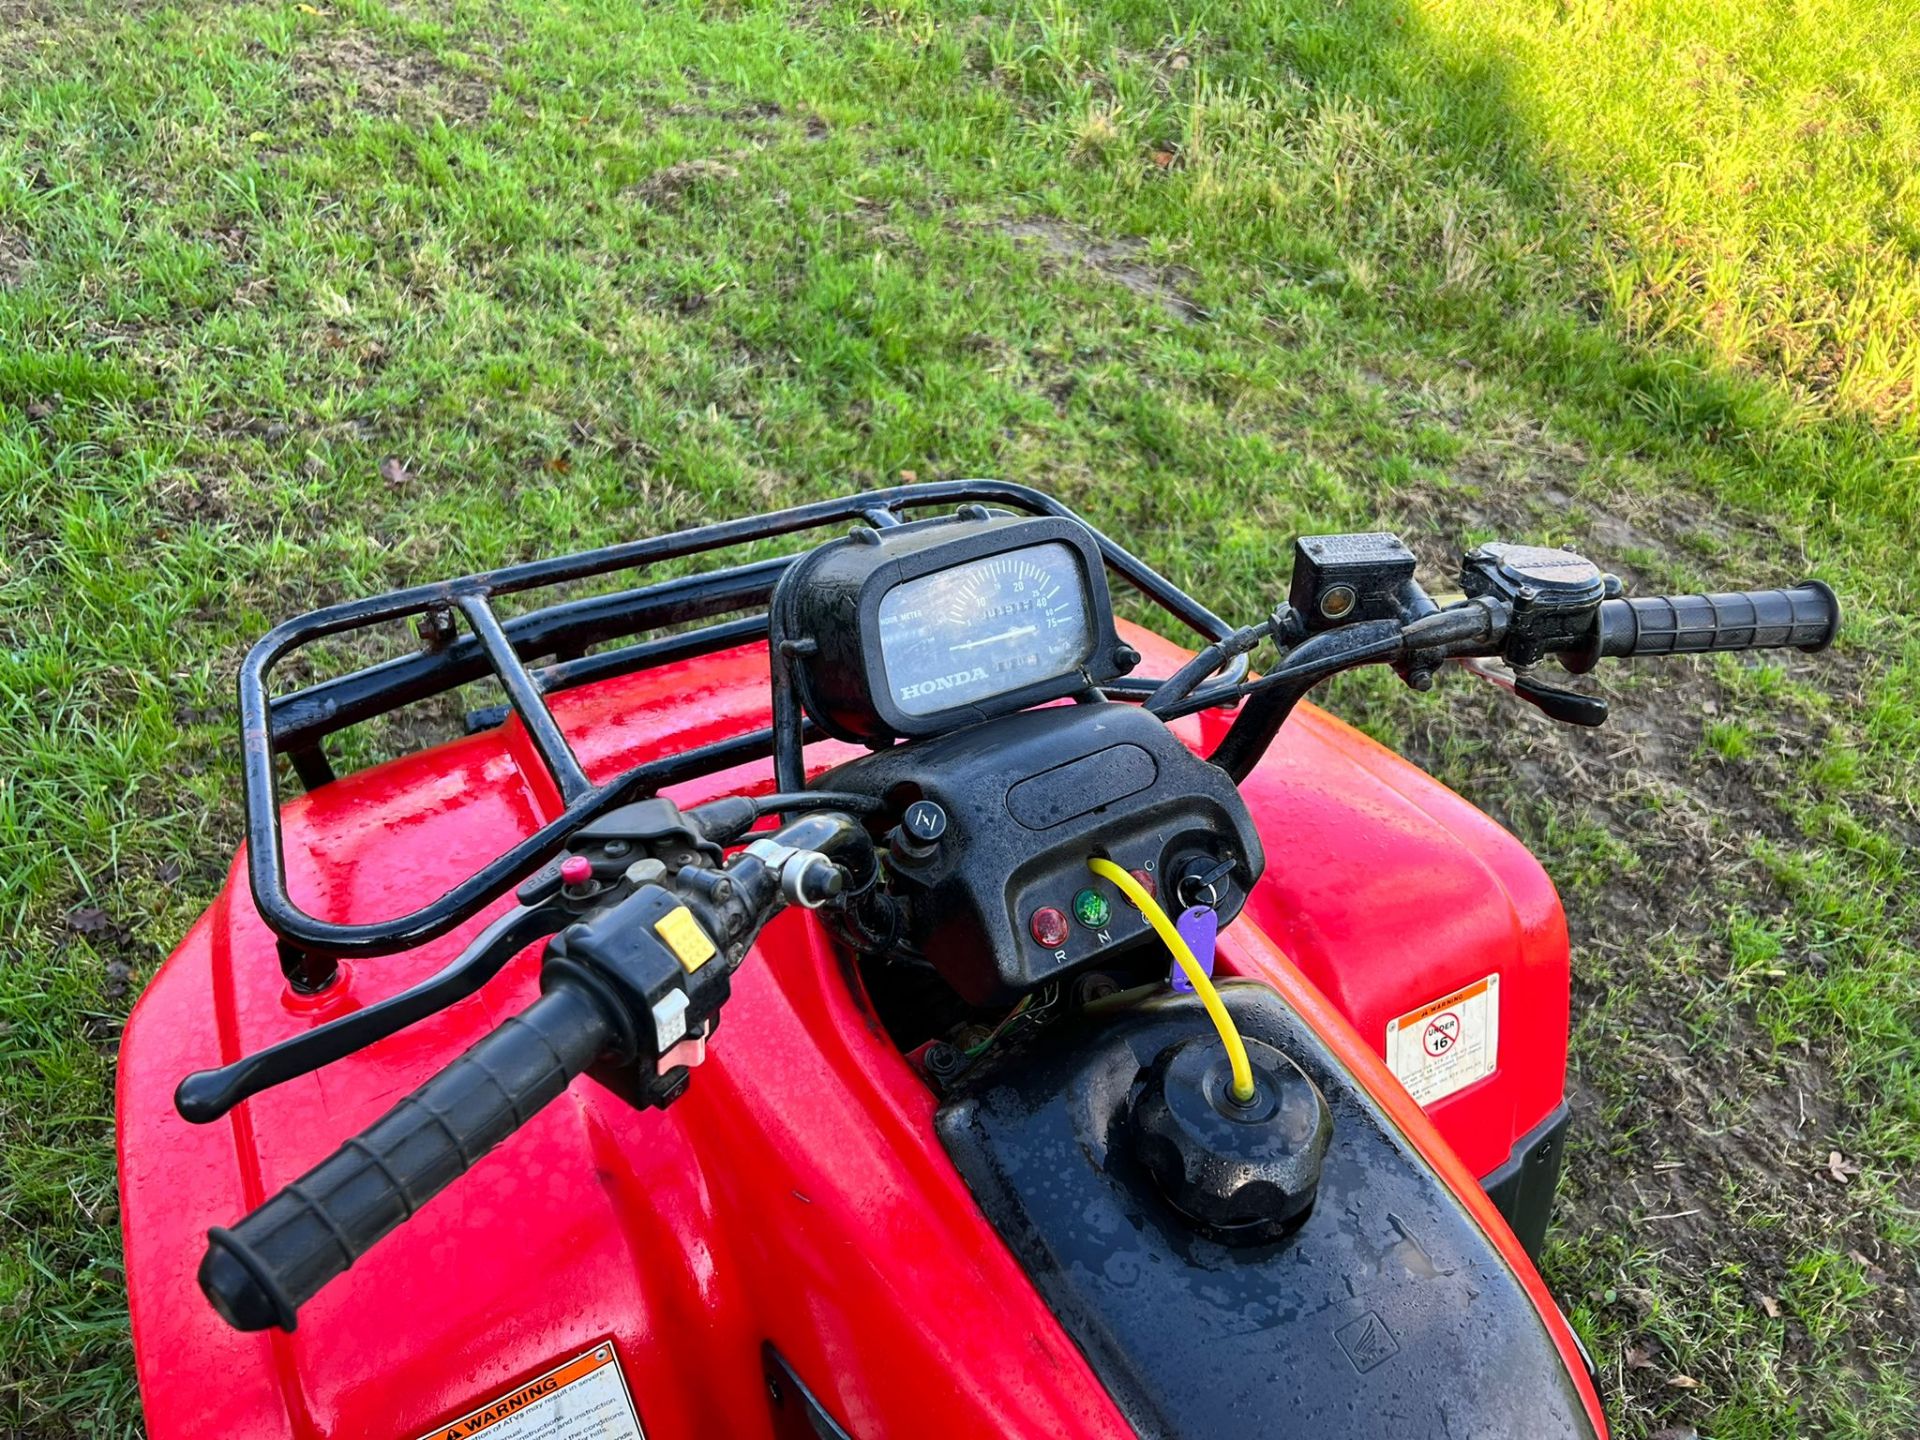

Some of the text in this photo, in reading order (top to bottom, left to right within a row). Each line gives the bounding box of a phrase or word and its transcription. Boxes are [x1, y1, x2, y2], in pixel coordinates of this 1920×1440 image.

[1013, 581, 1024, 592] 20
[976, 597, 986, 608] 10
[1036, 597, 1047, 608] 40
[1046, 617, 1057, 628] 75
[900, 667, 989, 700] HONDA
[1097, 929, 1112, 943] N
[1054, 949, 1067, 963] R
[1430, 994, 1463, 1011] WARNING
[1428, 1020, 1455, 1036] UNDER
[1433, 1036, 1448, 1050] 16
[464, 1378, 558, 1431] WARNING
[503, 1411, 524, 1426] ATVs
[525, 1402, 543, 1414] may
[544, 1388, 568, 1404] result
[568, 1384, 577, 1393] in
[578, 1369, 605, 1387] severe
[557, 1417, 573, 1430] and
